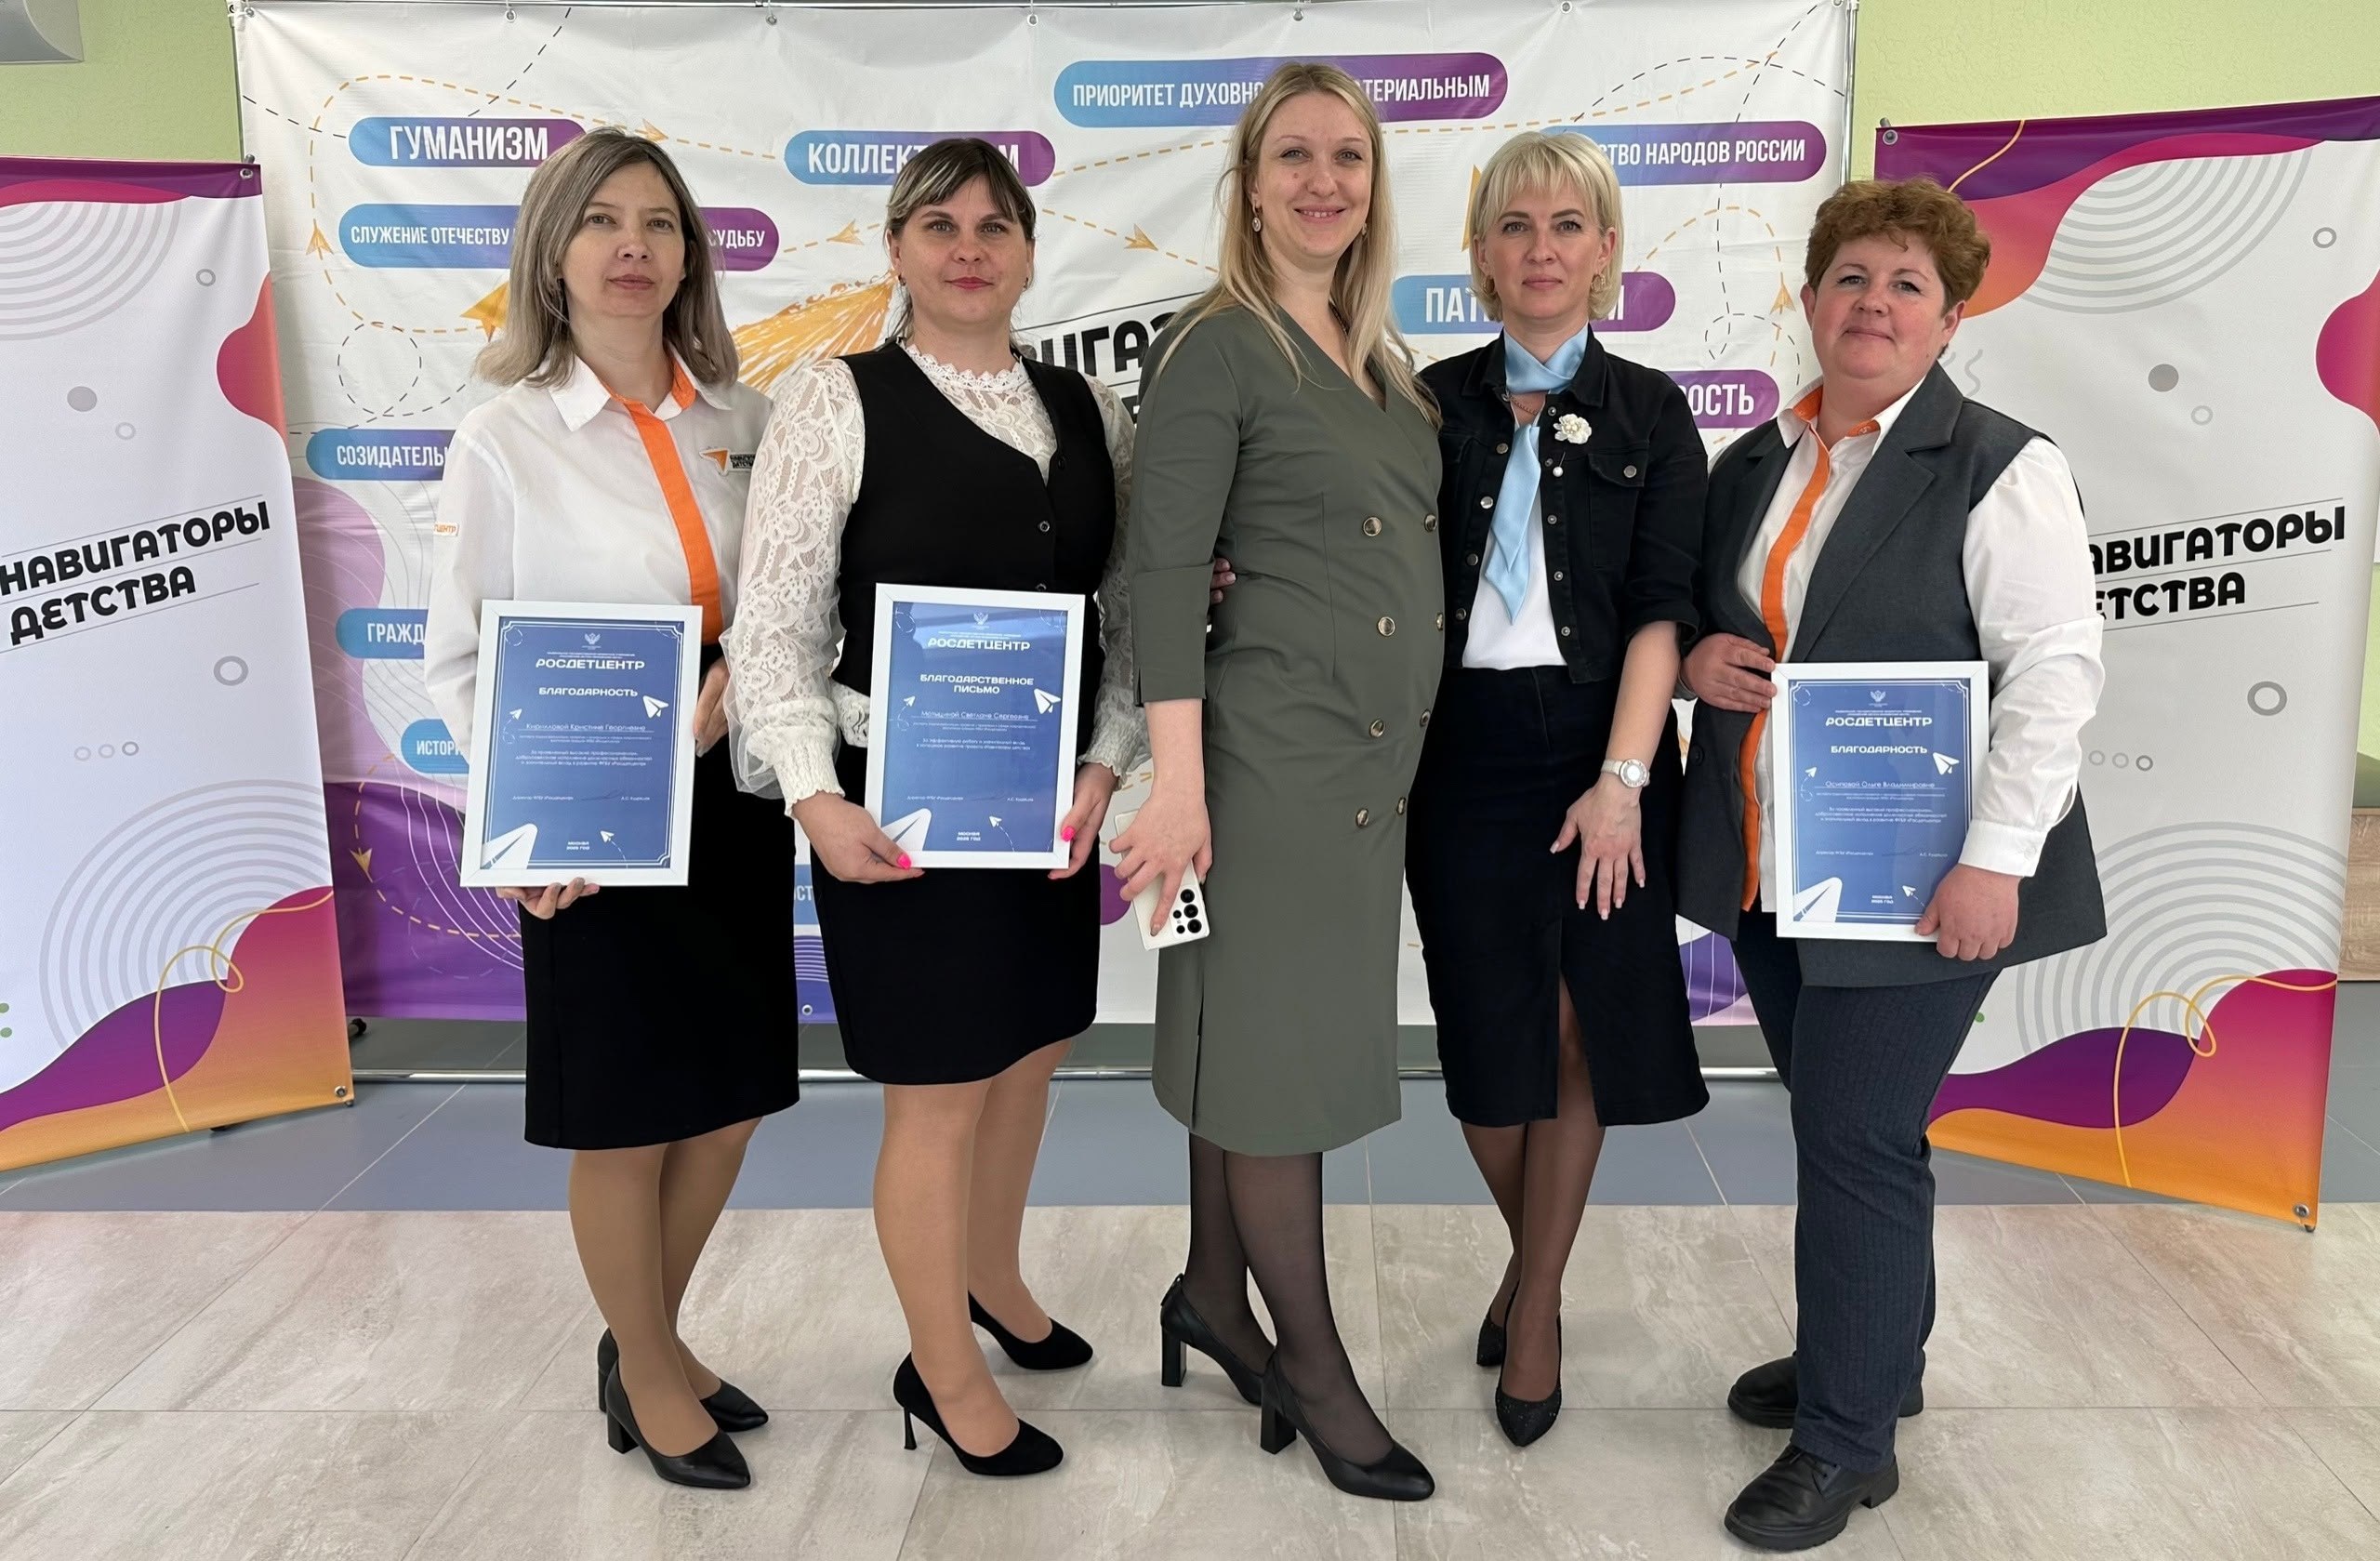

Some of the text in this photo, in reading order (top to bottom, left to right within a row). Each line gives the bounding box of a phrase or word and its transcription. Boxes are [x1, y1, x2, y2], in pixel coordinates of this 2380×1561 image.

[1072, 84, 1175, 107] ПРИОРИТЕТ
[1355, 74, 1490, 102] ТЕРИАЛЬНЫМ
[389, 126, 549, 161] ГУМАНИЗМ
[1645, 141, 1730, 166] НАРОДОВ
[1735, 139, 1805, 164] РОССИИ
[350, 226, 509, 245] СЛУЖЕНИЕ ОТЕЧЕСТВУ
[337, 445, 449, 469] СОЗИДАТЕЛЬ
[0, 501, 271, 596] НАВИГАТОРЫ
[10, 565, 196, 646] ДЕТСТВА
[927, 637, 1031, 652] РОСДЕТЦЕНТР
[536, 658, 645, 670] РОСДЕТЦЕНТР
[919, 673, 1035, 686] БЛАГОДАРСТВЕННОЕ
[538, 687, 639, 697] БЛАГОДАРНОСТЬ
[953, 684, 1000, 695] ПИСЬМО
[1825, 717, 1933, 727] РОСДЕТЦЕНТР
[416, 740, 458, 756] ИСТОР
[1830, 745, 1928, 754] БЛАГОДАРНОСТЬ
